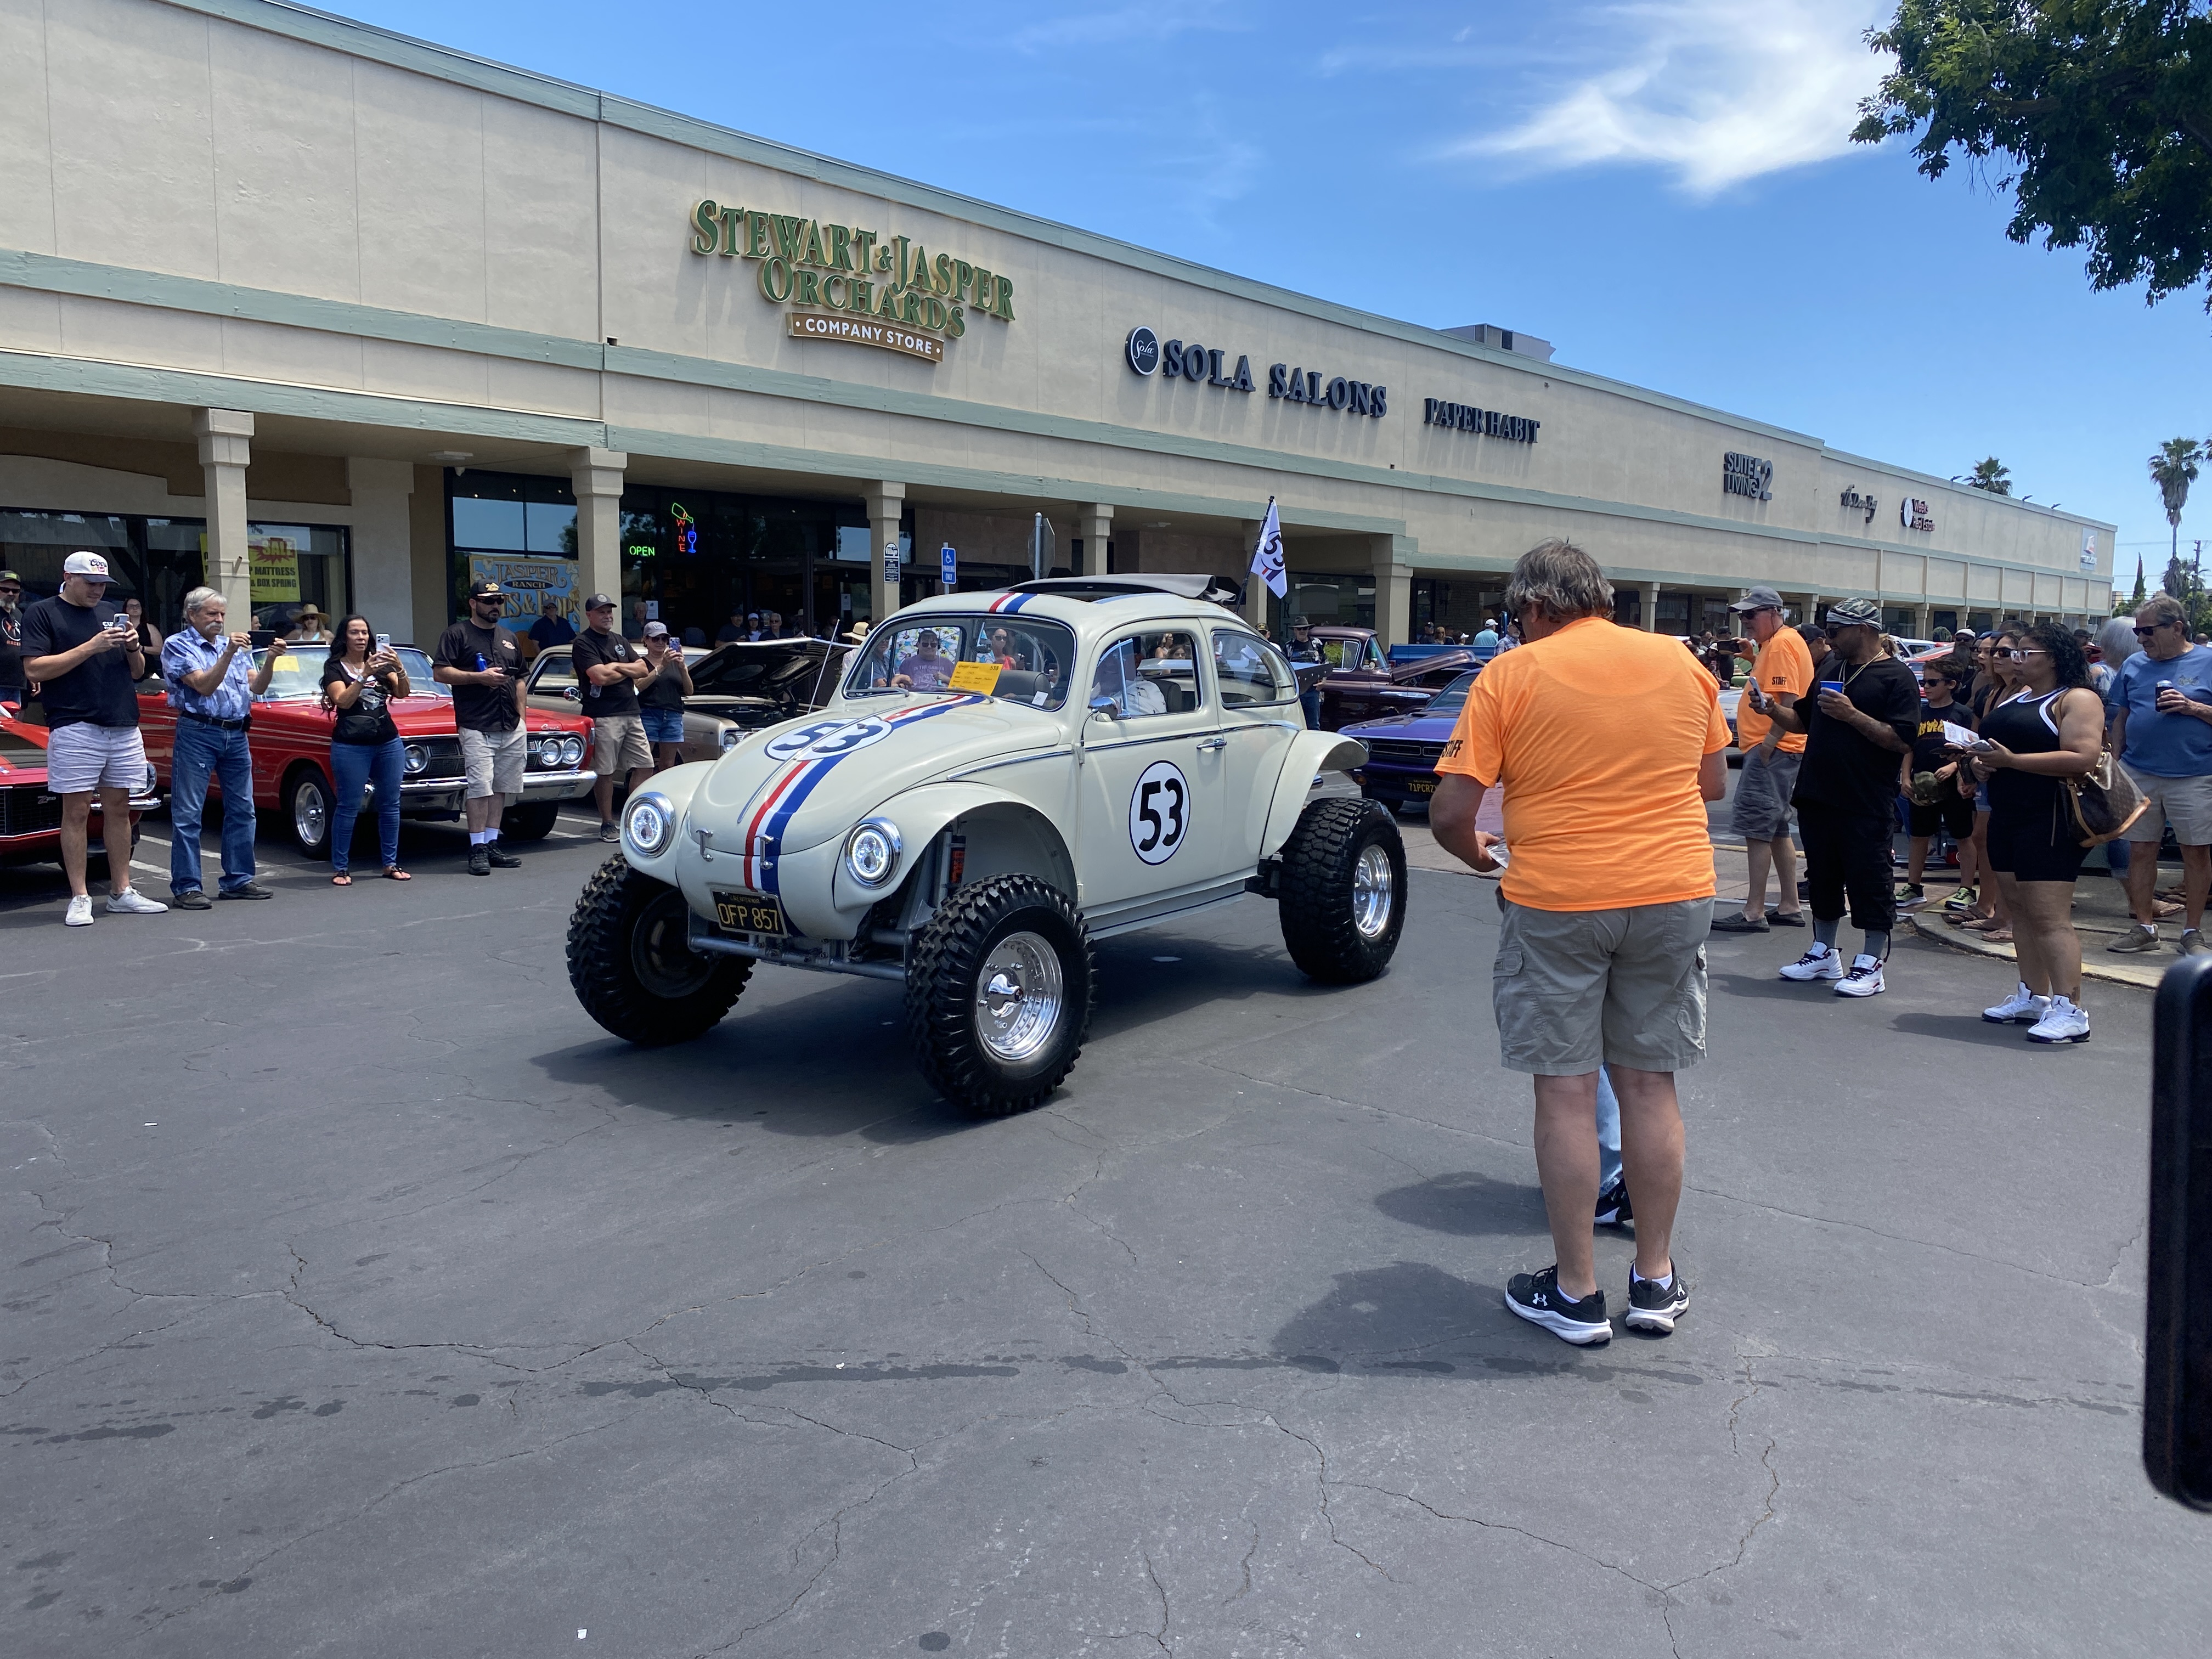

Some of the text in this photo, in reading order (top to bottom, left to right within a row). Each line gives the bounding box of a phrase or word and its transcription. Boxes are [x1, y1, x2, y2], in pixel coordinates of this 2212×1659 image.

[690, 200, 1015, 321] STEWART & JASPER
[757, 256, 966, 338] ORCHARDS
[805, 318, 932, 354] COMPANY STORE
[1133, 340, 1156, 359] Sola
[1163, 339, 1387, 417] SOLA SALONS
[1424, 398, 1541, 443] PAPER HABIT
[1724, 451, 1773, 500] SUITE 52
[1724, 473, 1758, 498] LIVING
[1912, 499, 1928, 514] Weeks
[676, 518, 686, 552] WINE
[1911, 516, 1924, 529] Real
[262, 540, 295, 556] SALE
[629, 546, 655, 556] OPEN
[255, 566, 295, 575] MATTRESS
[257, 578, 270, 587] BOX
[272, 579, 296, 588] SPRING
[496, 564, 567, 589] JASPER
[512, 580, 546, 589] RANCH
[521, 593, 537, 615] &
[1771, 676, 1787, 685] STAFF
[771, 722, 883, 753] 53
[1139, 778, 1183, 851] 53
[718, 903, 778, 931] OFP 857
